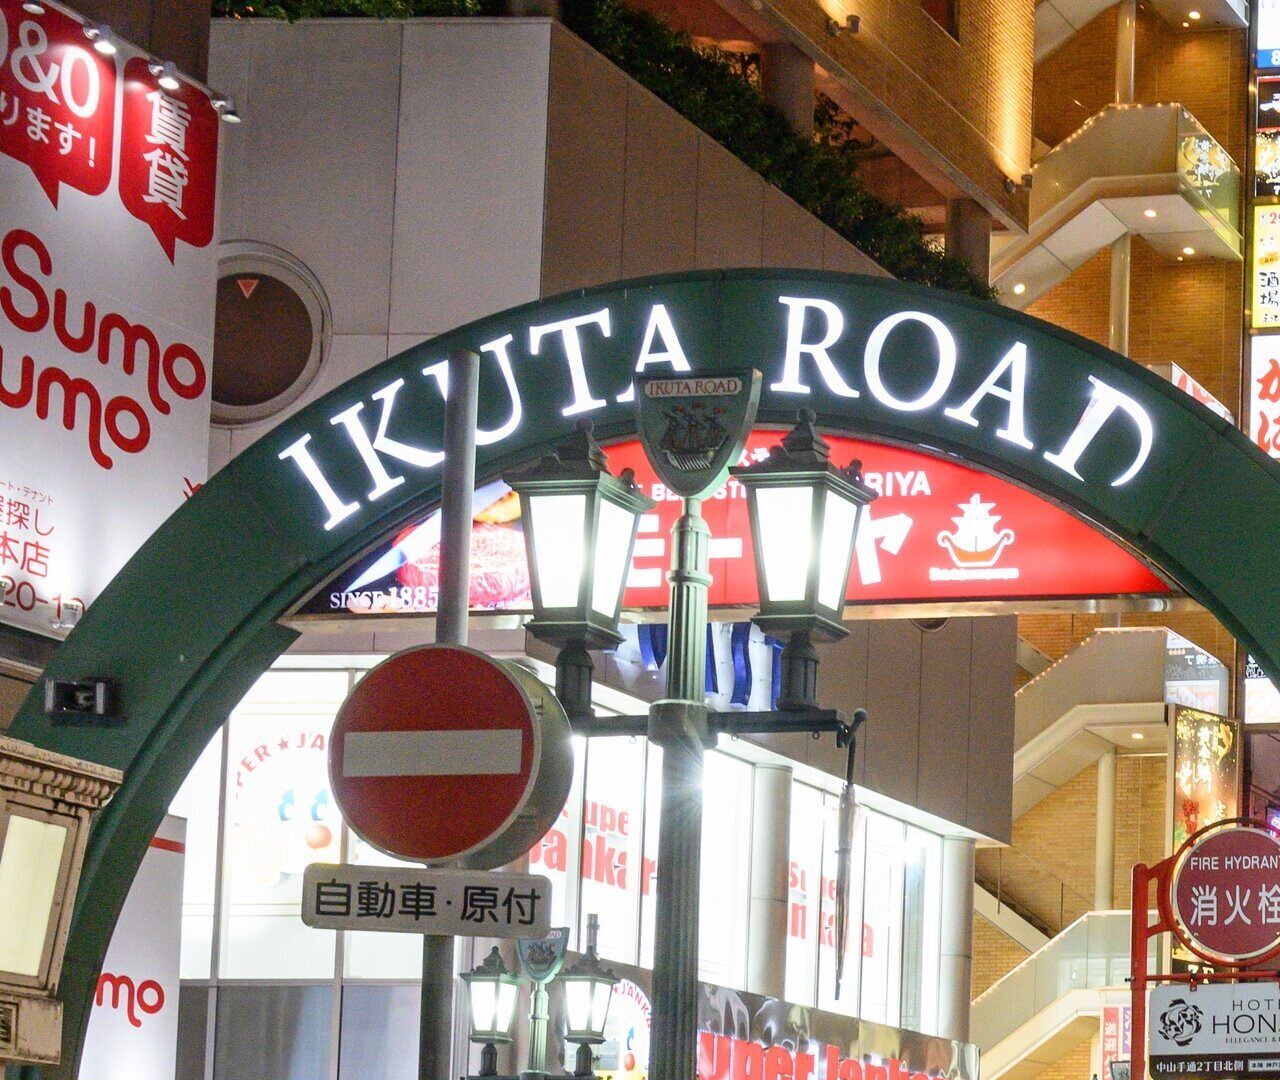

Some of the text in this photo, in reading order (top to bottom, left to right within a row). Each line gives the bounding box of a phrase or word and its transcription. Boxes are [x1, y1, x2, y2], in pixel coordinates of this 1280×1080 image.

[143, 90, 192, 220] 賃貸
[1259, 271, 1280, 307] 酒場
[0, 229, 206, 415] Sumo
[649, 378, 738, 396] IKUTA ROAD
[278, 296, 1154, 531] IKUTA ROAD
[1190, 856, 1219, 870] FIRE
[314, 879, 542, 926] 自動車・原付
[1156, 1060, 1244, 1073] 中山手通2丁目北側
